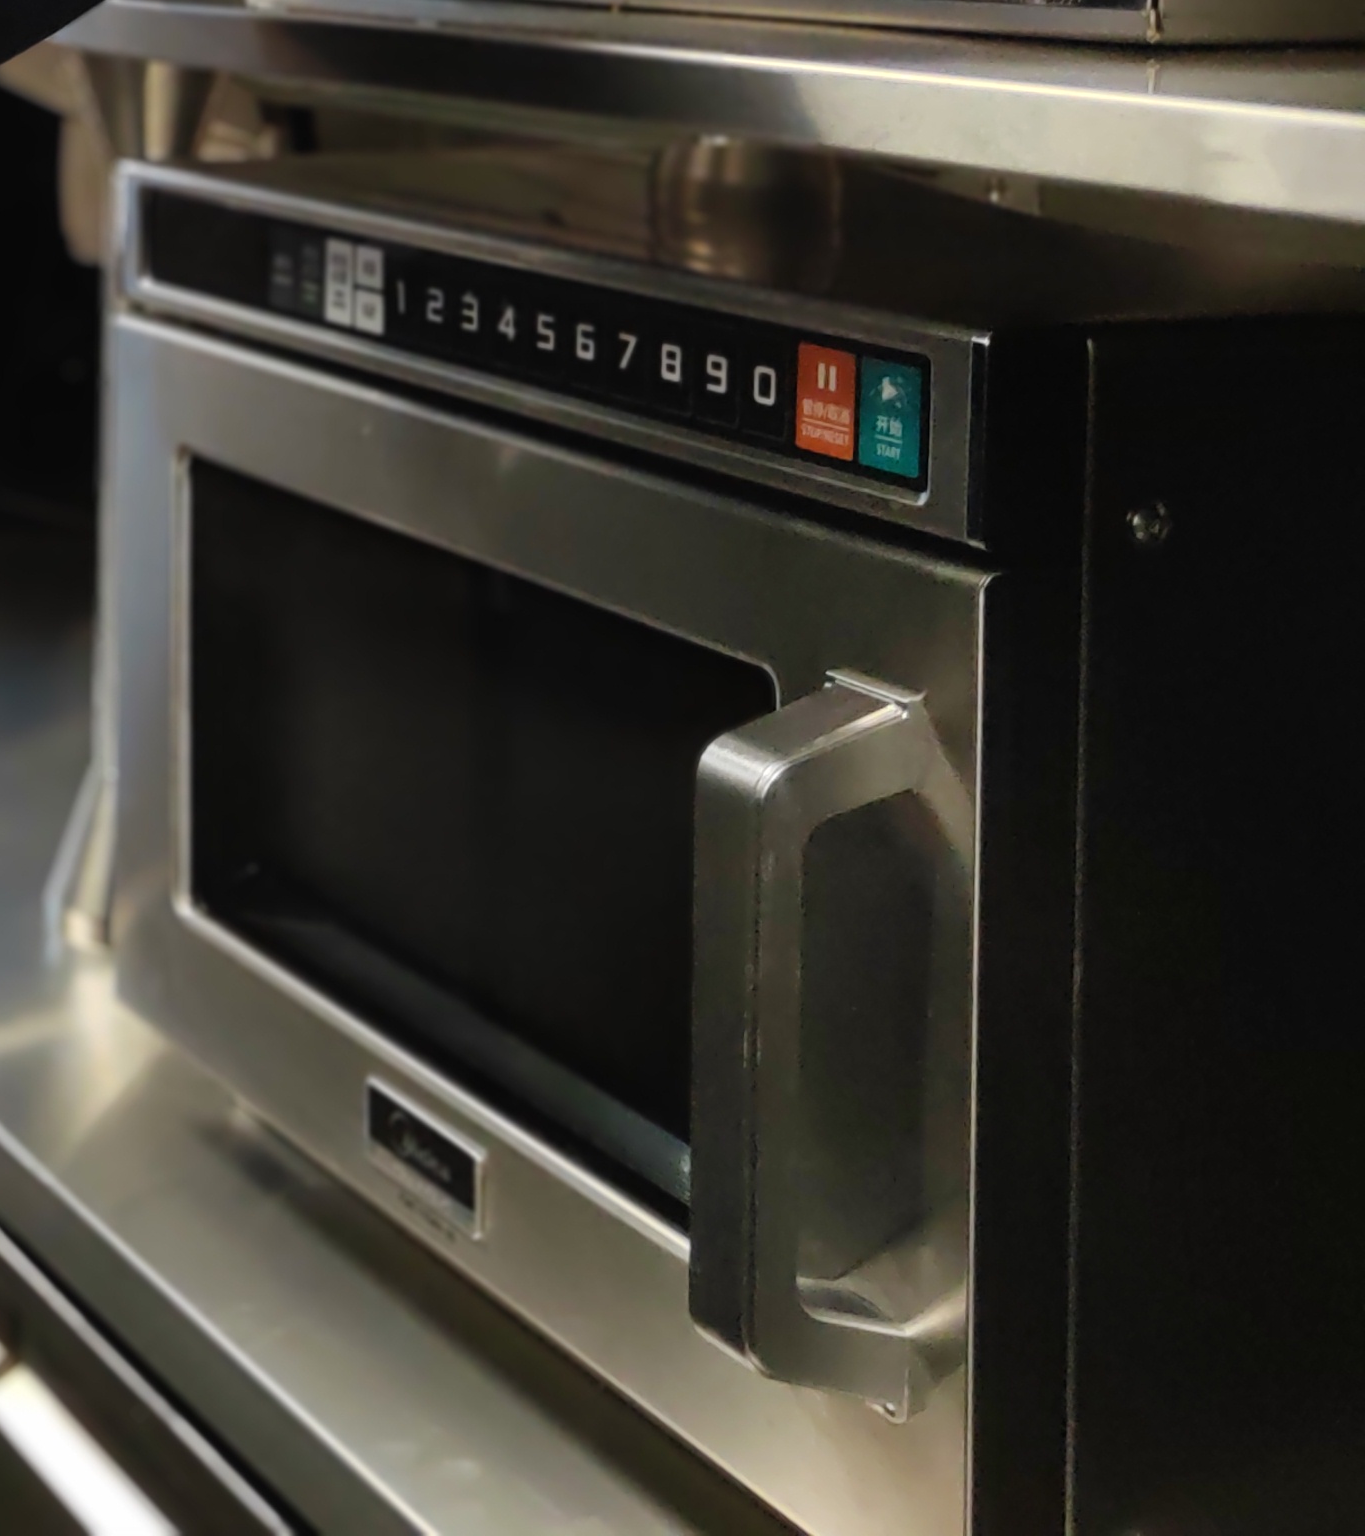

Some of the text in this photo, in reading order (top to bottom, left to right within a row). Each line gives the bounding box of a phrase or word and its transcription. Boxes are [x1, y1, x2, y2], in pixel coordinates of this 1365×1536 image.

[397, 279, 405, 314] 1
[426, 287, 444, 324] 2
[461, 292, 478, 332] 3
[498, 306, 516, 341] 4
[536, 314, 555, 351] 5
[576, 323, 595, 361] 6
[619, 332, 637, 369] 7
[661, 343, 682, 382] 8
[706, 354, 728, 394] 9
[753, 365, 776, 406] 0
[876, 443, 901, 460] START
